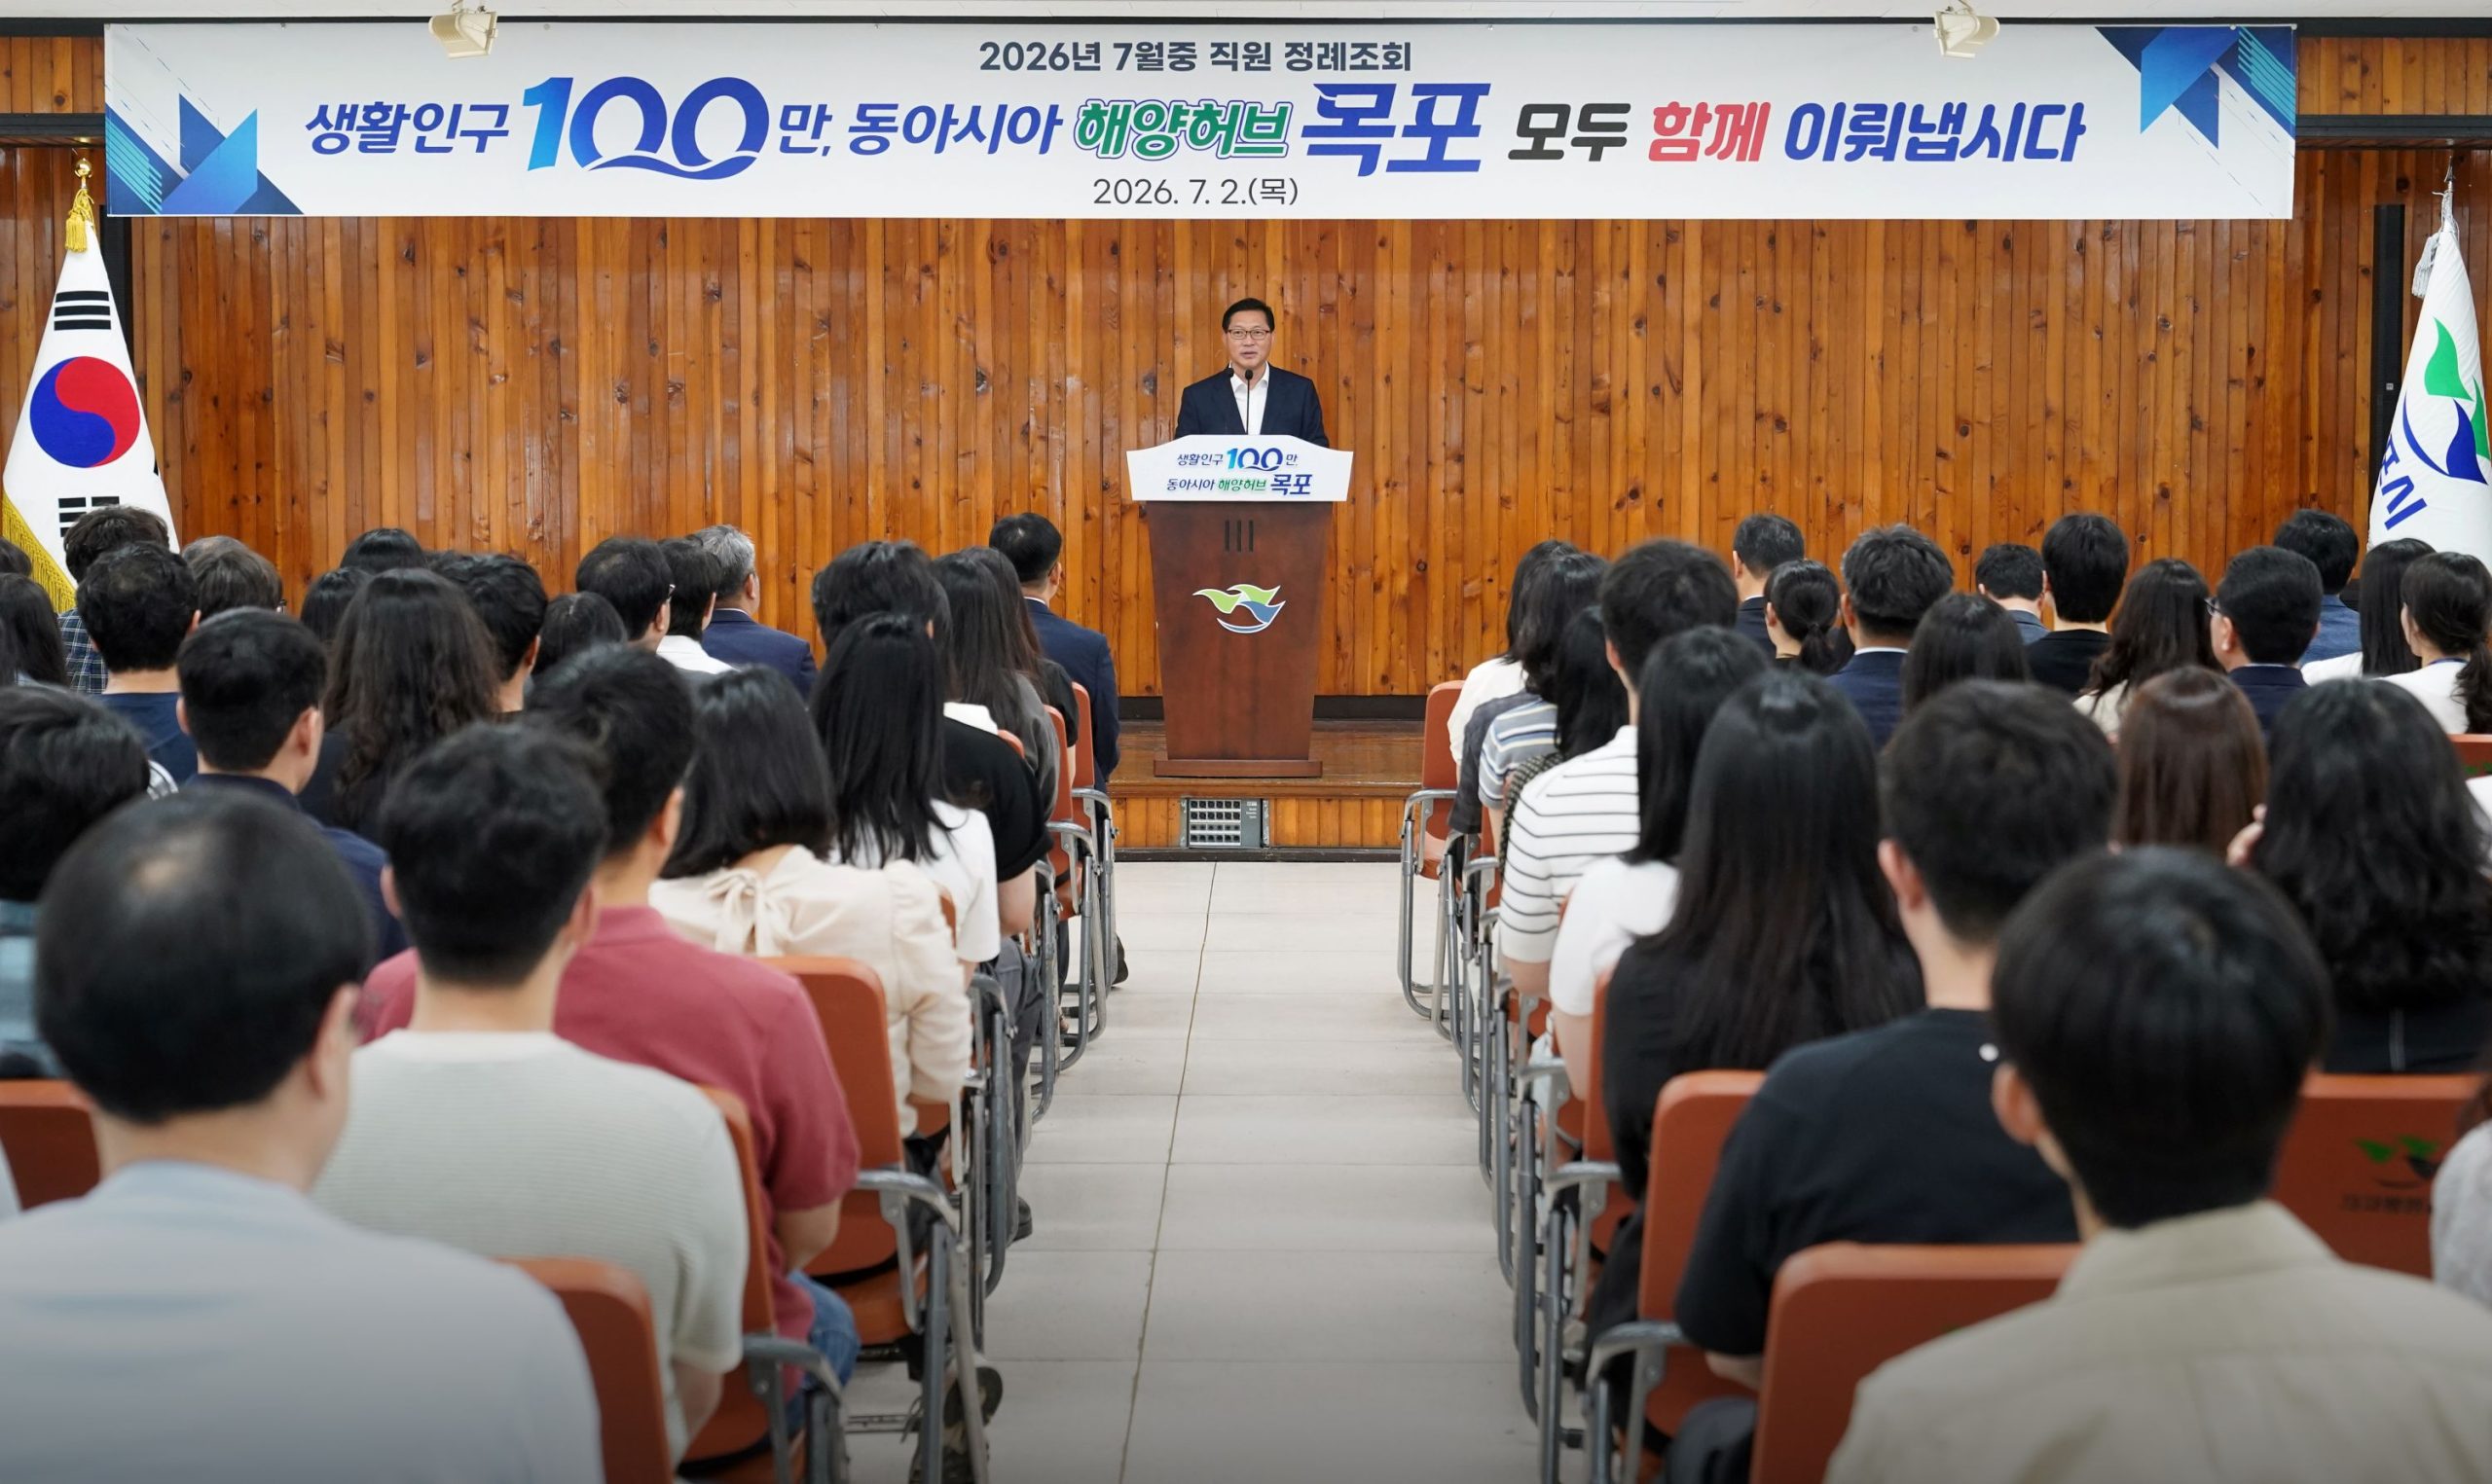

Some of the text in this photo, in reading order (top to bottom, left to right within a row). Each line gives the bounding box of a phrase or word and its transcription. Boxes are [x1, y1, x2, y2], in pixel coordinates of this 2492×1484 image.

[979, 41, 1412, 72] 2026년 7월중 직원 정례조회
[305, 100, 510, 156] 생활인구
[847, 102, 1064, 157] 동아시아
[1074, 98, 1295, 161] 해양허브
[1301, 82, 1492, 177] 목포
[1507, 102, 1631, 163] 모두
[1648, 100, 1772, 163] 함께
[1783, 101, 2087, 163] 이뤄냅시다
[1093, 177, 1299, 207] 2026. 7. 2.(목)
[1176, 453, 1224, 467] 생활인구
[1167, 473, 1313, 496] 동아시아 해양허브 목포
